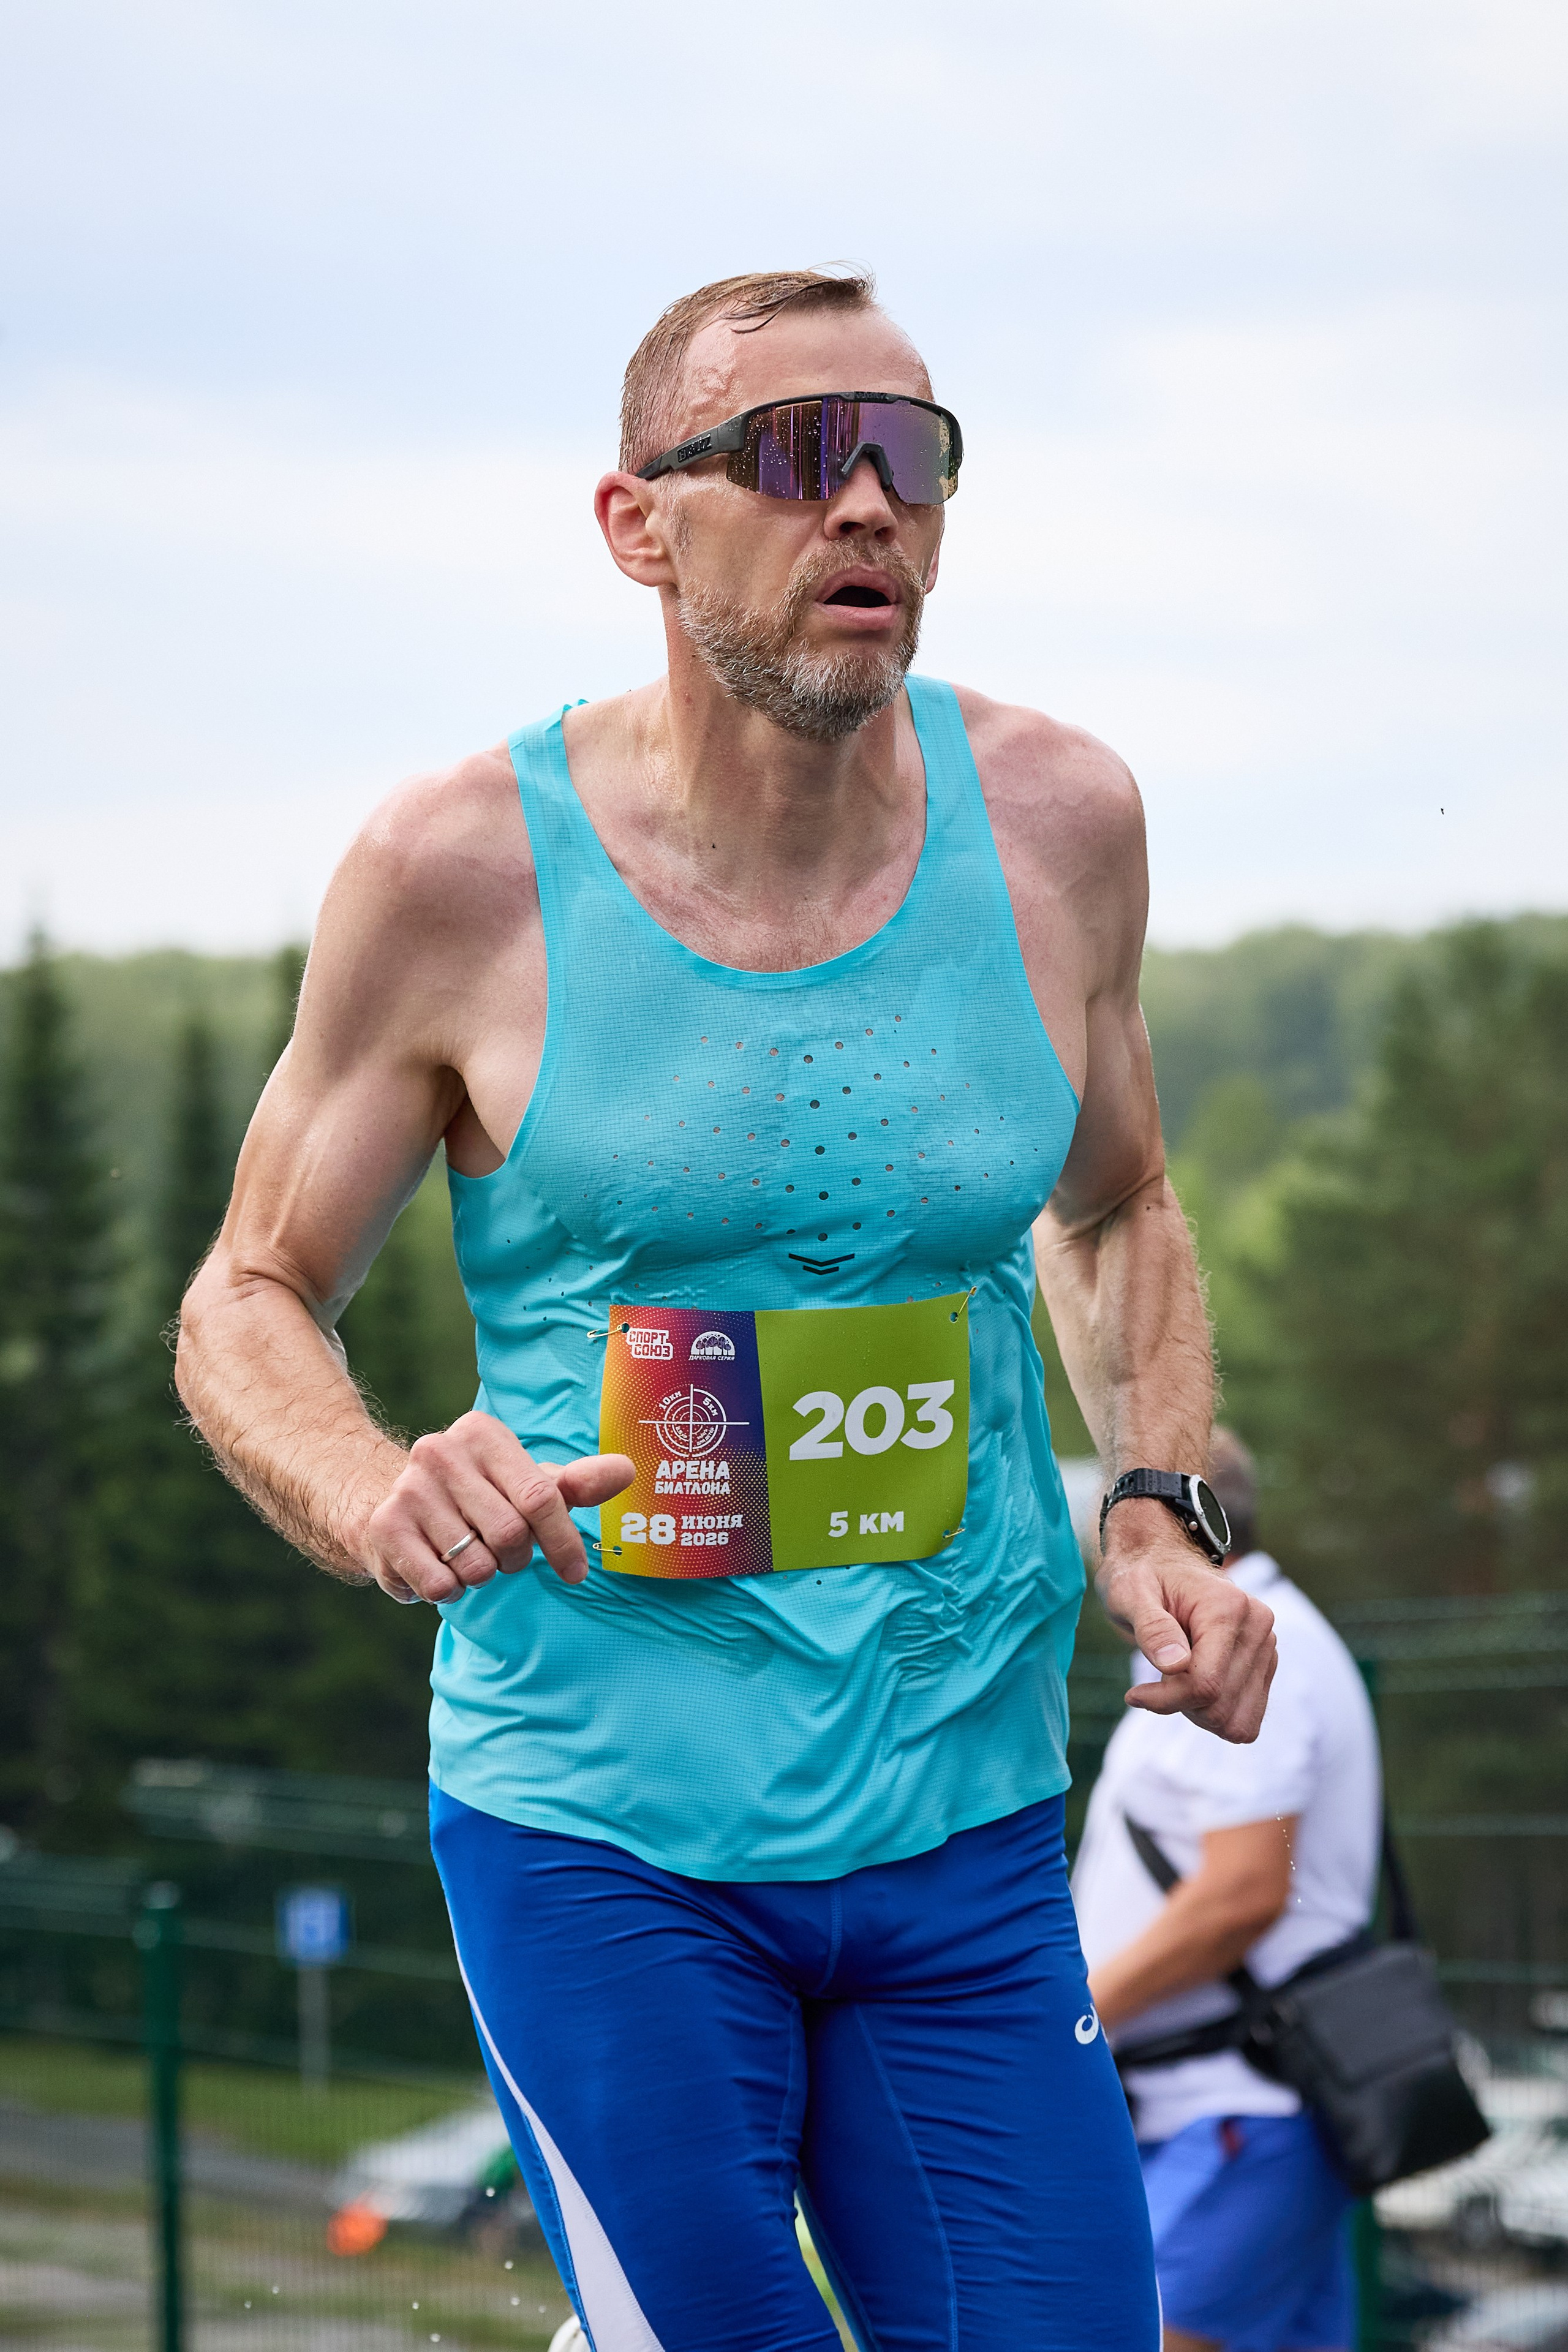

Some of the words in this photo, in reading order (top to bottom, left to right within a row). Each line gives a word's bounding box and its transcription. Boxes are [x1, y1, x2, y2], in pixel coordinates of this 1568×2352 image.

[629, 1331, 666, 1344] СПОРТ
[634, 1344, 670, 1357] СОЮЗ
[790, 1379, 955, 1461] 203
[655, 1460, 730, 1480] АРЕНА
[655, 1481, 731, 1494] БИАТЛОНА
[620, 1512, 676, 1545] 28
[680, 1514, 744, 1529] ИЮНЯ
[828, 1510, 849, 1537] 5
[680, 1532, 729, 1547] 2026
